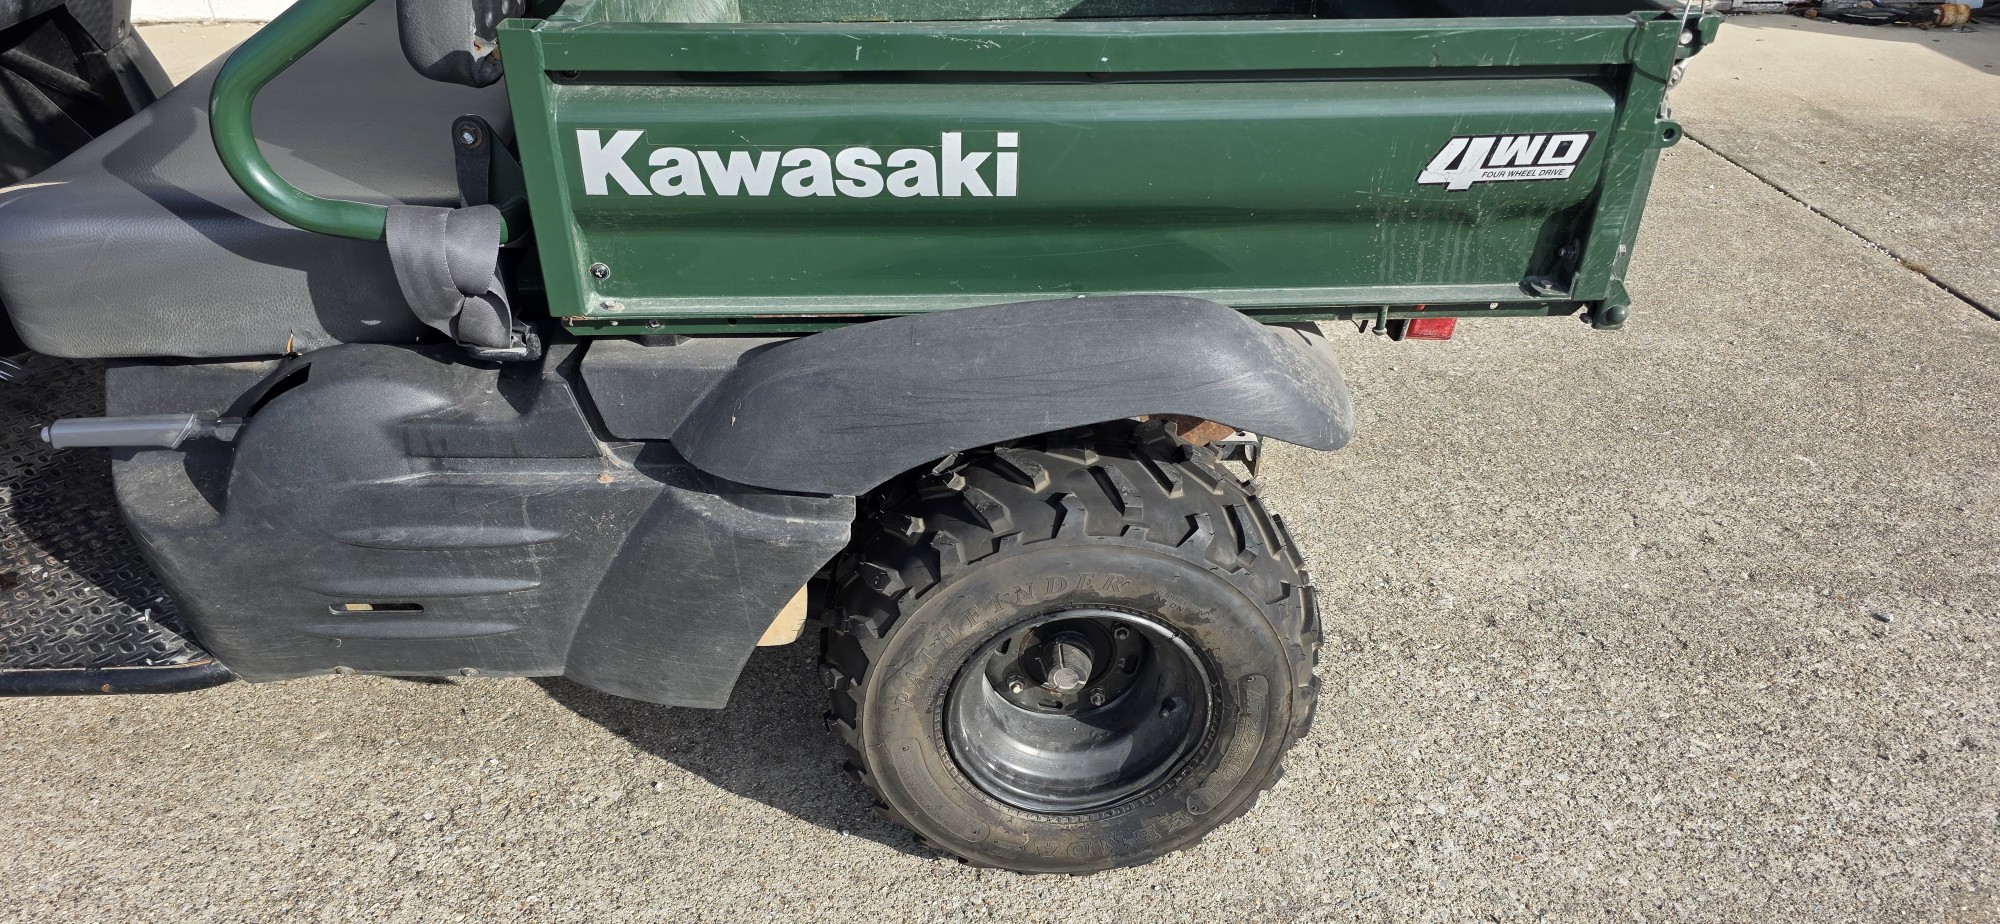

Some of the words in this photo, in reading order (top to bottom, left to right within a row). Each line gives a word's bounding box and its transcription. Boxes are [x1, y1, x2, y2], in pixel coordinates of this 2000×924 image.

[576, 129, 1018, 197] Kawasaki
[1417, 134, 1590, 190] 4WD
[1507, 170, 1536, 178] WHEEL
[1538, 168, 1566, 177] DRIVE
